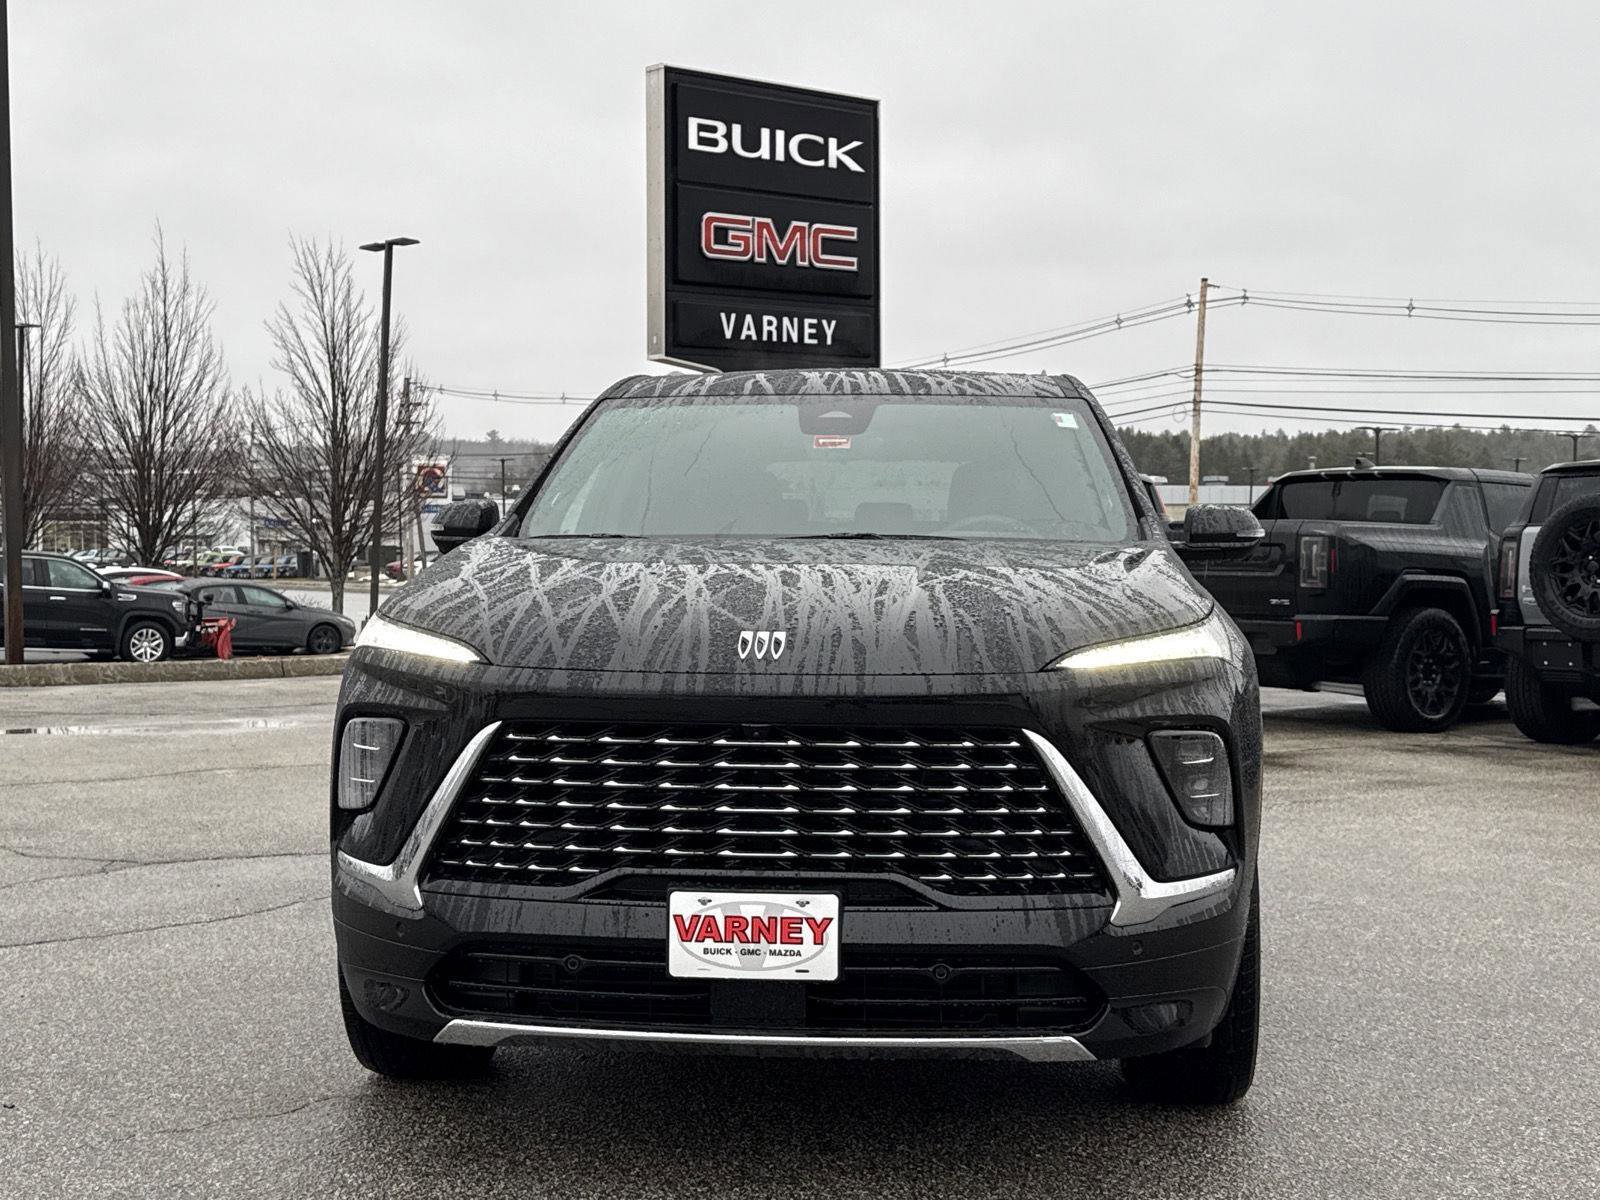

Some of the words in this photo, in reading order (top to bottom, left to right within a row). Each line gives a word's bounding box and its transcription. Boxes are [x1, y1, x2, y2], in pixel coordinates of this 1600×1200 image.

[687, 116, 866, 173] BUICK
[701, 211, 858, 272] GMC
[719, 311, 837, 346] VARNEY
[672, 914, 834, 946] VARNEY
[703, 947, 732, 956] BUICK
[740, 948, 761, 956] GMC
[769, 948, 802, 957] MAZDA
